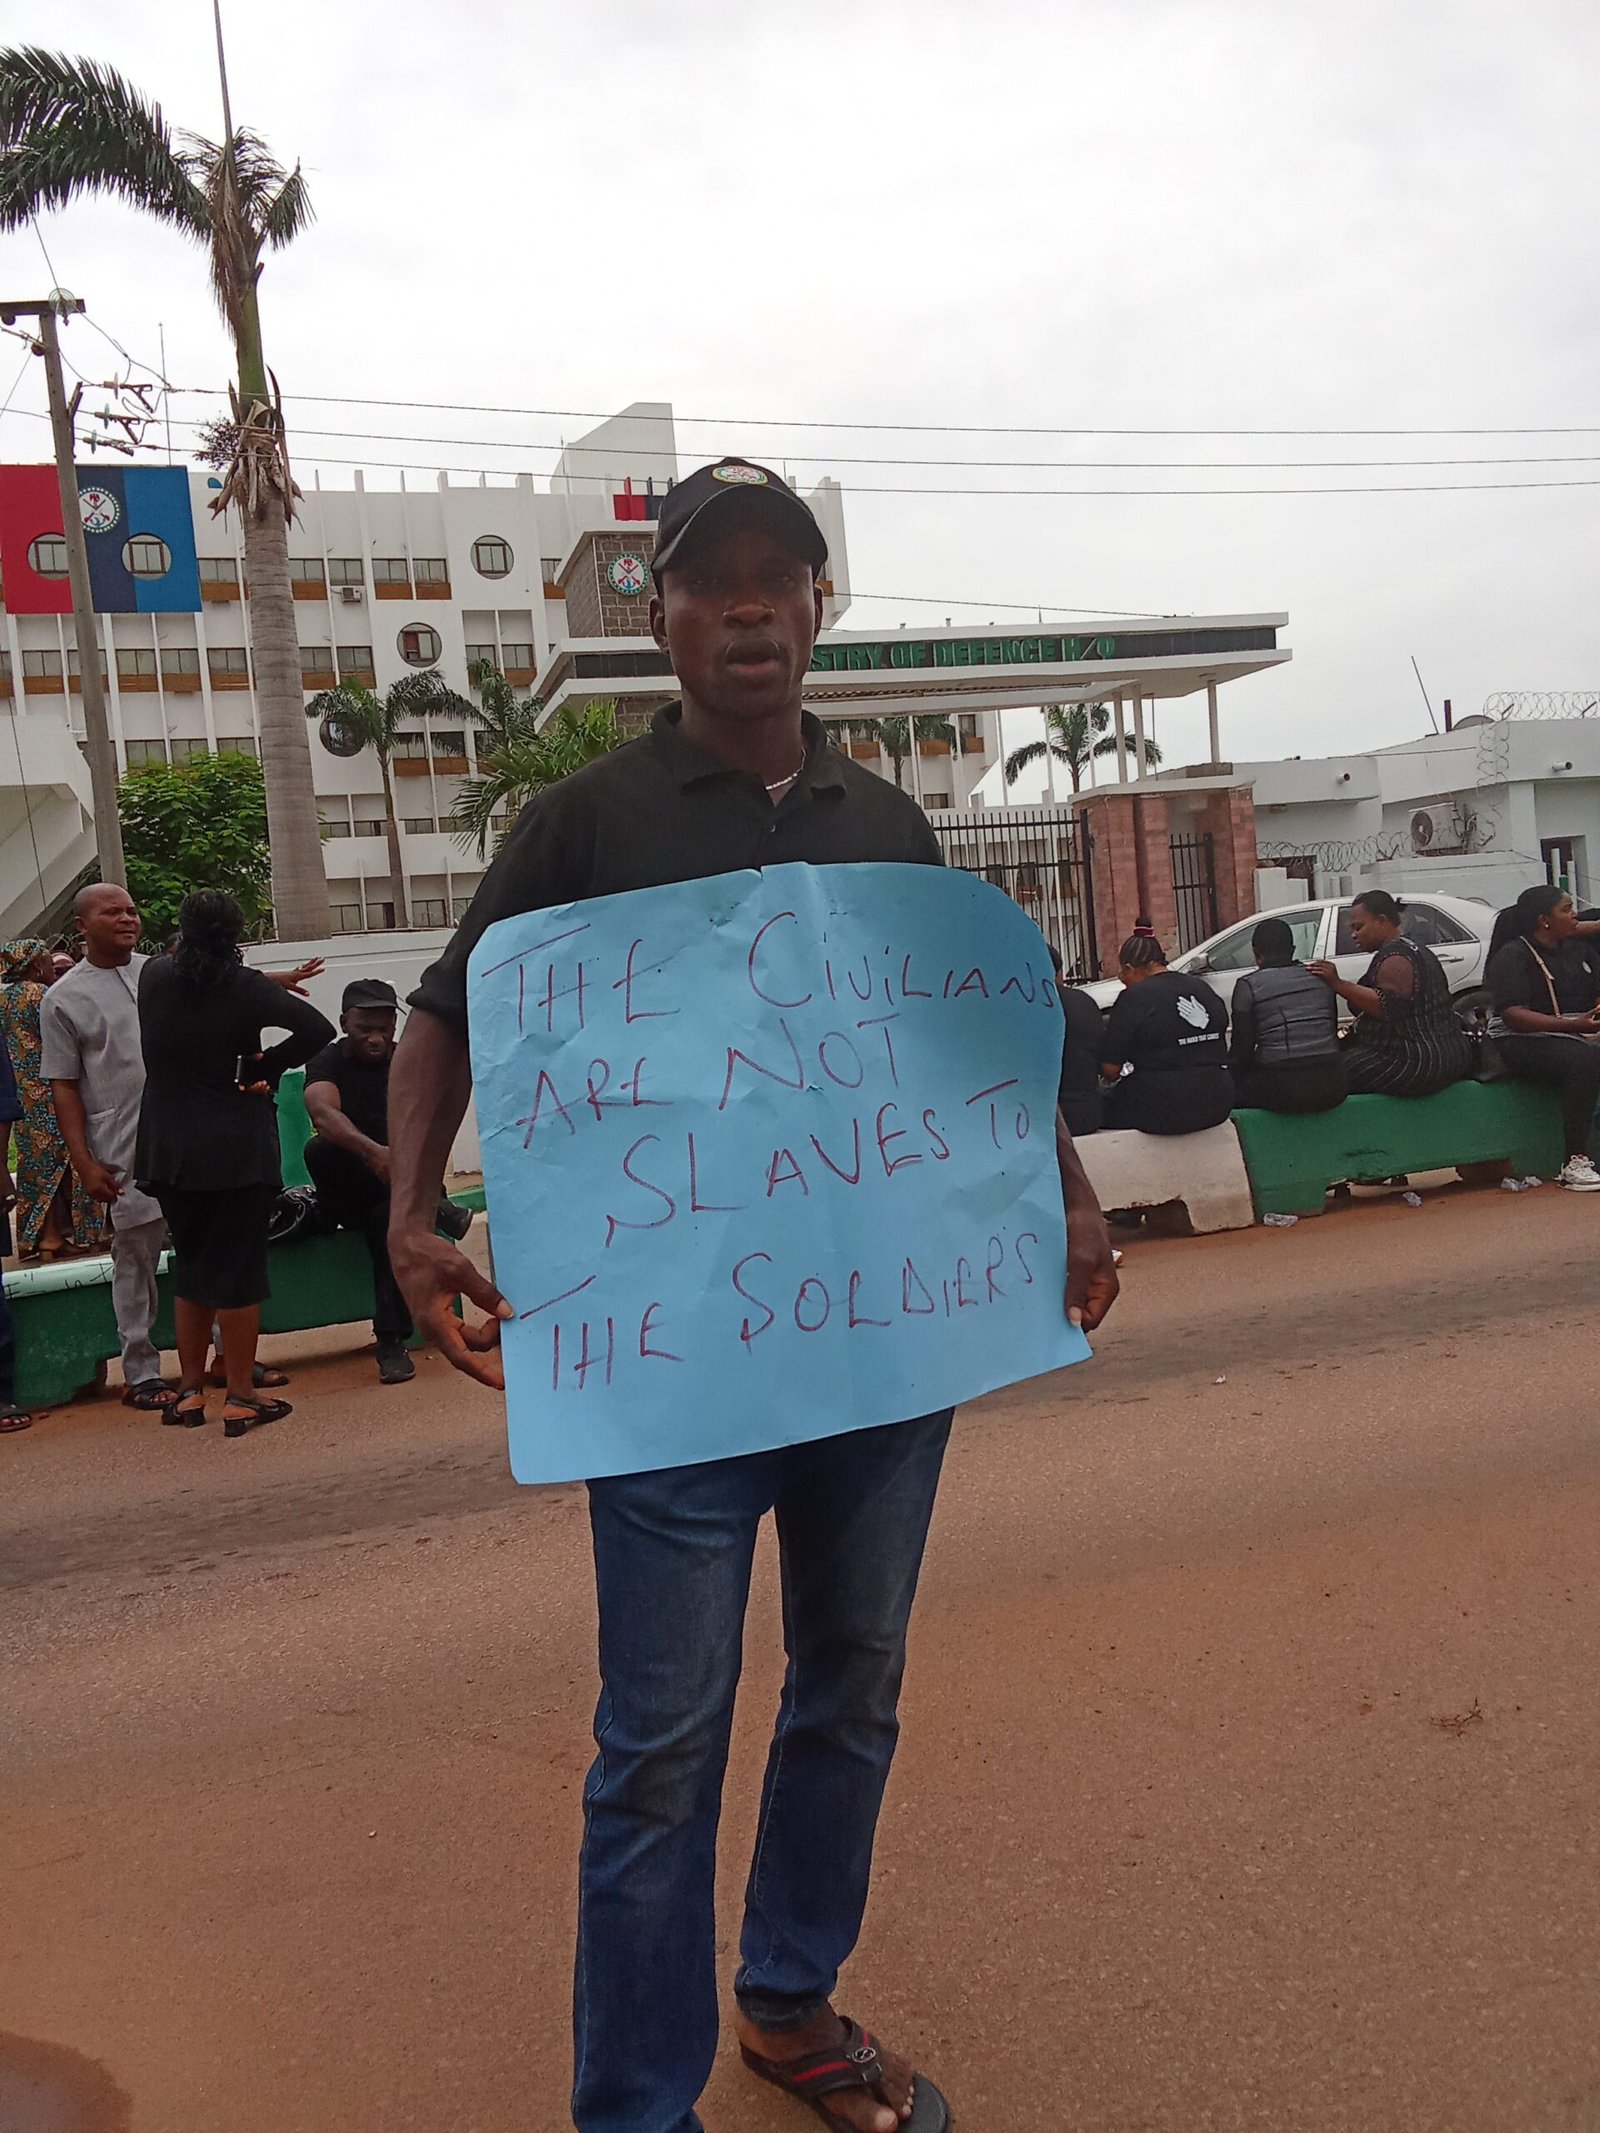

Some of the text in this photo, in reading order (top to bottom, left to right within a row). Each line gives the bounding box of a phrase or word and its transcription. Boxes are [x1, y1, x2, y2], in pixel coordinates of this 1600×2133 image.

[809, 643, 884, 671] STRY
[890, 642, 927, 668] OF
[933, 637, 1057, 667] DEFENCE
[482, 923, 681, 1036] THE
[515, 1013, 900, 1149] ARE NOT
[605, 1079, 1030, 1248] SLAVES TO
[519, 1233, 1038, 1391] THE SOLDIERS
